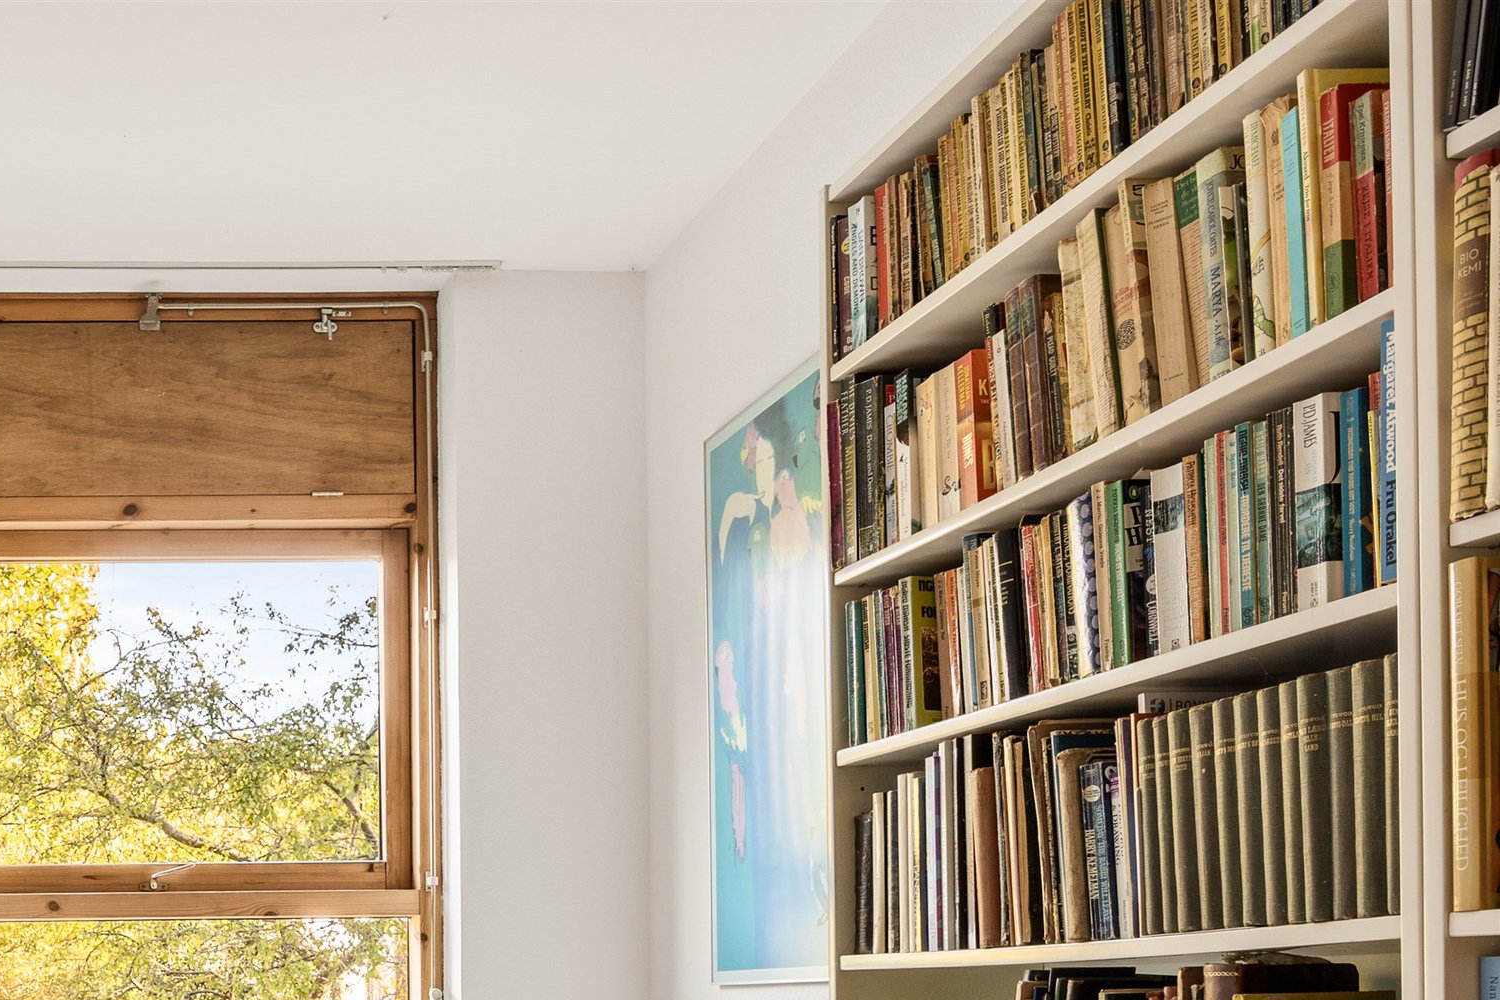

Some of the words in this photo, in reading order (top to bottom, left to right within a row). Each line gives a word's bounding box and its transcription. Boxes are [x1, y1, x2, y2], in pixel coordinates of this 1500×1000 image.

[1067, 11, 1076, 35] Agatha
[1077, 2, 1086, 19] THE
[1190, 4, 1199, 22] THE
[1078, 20, 1087, 43] BODY
[1094, 15, 1102, 44] Christie
[1218, 16, 1227, 57] UNKNOWN
[1069, 36, 1078, 63] Christie
[1080, 43, 1087, 55] IN
[1191, 27, 1200, 73] FUNERAL
[1072, 81, 1080, 106] FROM
[1082, 73, 1091, 110] LIBRARY
[1085, 113, 1093, 137] Christie
[1357, 104, 1365, 121] Tom
[1074, 107, 1083, 161] PADDINGTON
[1322, 119, 1336, 163] ITALIEN
[1205, 180, 1216, 204] JOYCE
[1361, 184, 1370, 222] REJSE
[1207, 205, 1218, 231] CAROL
[851, 223, 860, 257] ANGELS
[902, 235, 910, 261] MURDER
[1208, 232, 1219, 257] OATES
[852, 258, 860, 277] AND
[1364, 232, 1373, 280] ITALIEN
[1457, 260, 1482, 281] KEMI
[1459, 248, 1479, 265] BIO
[858, 256, 867, 303] BROWN
[1210, 266, 1223, 317] MARYA
[852, 279, 861, 316] DEMONS
[1213, 331, 1225, 349] Life
[963, 364, 971, 401] JONATHAN
[1384, 331, 1396, 407] Margaret
[840, 390, 849, 436] FEATHER
[957, 363, 966, 411] KELLERMAN
[962, 432, 974, 468] BONES
[866, 434, 874, 461] Devices
[885, 415, 894, 472] CROMBIE
[1301, 421, 1318, 449] JAMES
[1386, 408, 1396, 474] Atwood
[845, 446, 854, 495] MINETTE
[866, 463, 874, 476] and
[1185, 461, 1194, 487] PATRICIA
[1257, 482, 1266, 496] DEN
[1386, 481, 1396, 509] Fru
[846, 497, 855, 543] WALTERS
[1145, 508, 1154, 543] NEST
[1241, 495, 1251, 540] MORDERE
[1242, 541, 1251, 553] TIL
[1258, 524, 1267, 543] DAME
[1386, 511, 1396, 567] Orakel
[1146, 600, 1157, 645] CORNWELL
[1455, 678, 1468, 722] HUS
[1455, 729, 1468, 759] OG
[1085, 828, 1096, 855] HARRY
[1111, 813, 1121, 866] DRAWING
[1087, 856, 1099, 900] KEMELMAN
